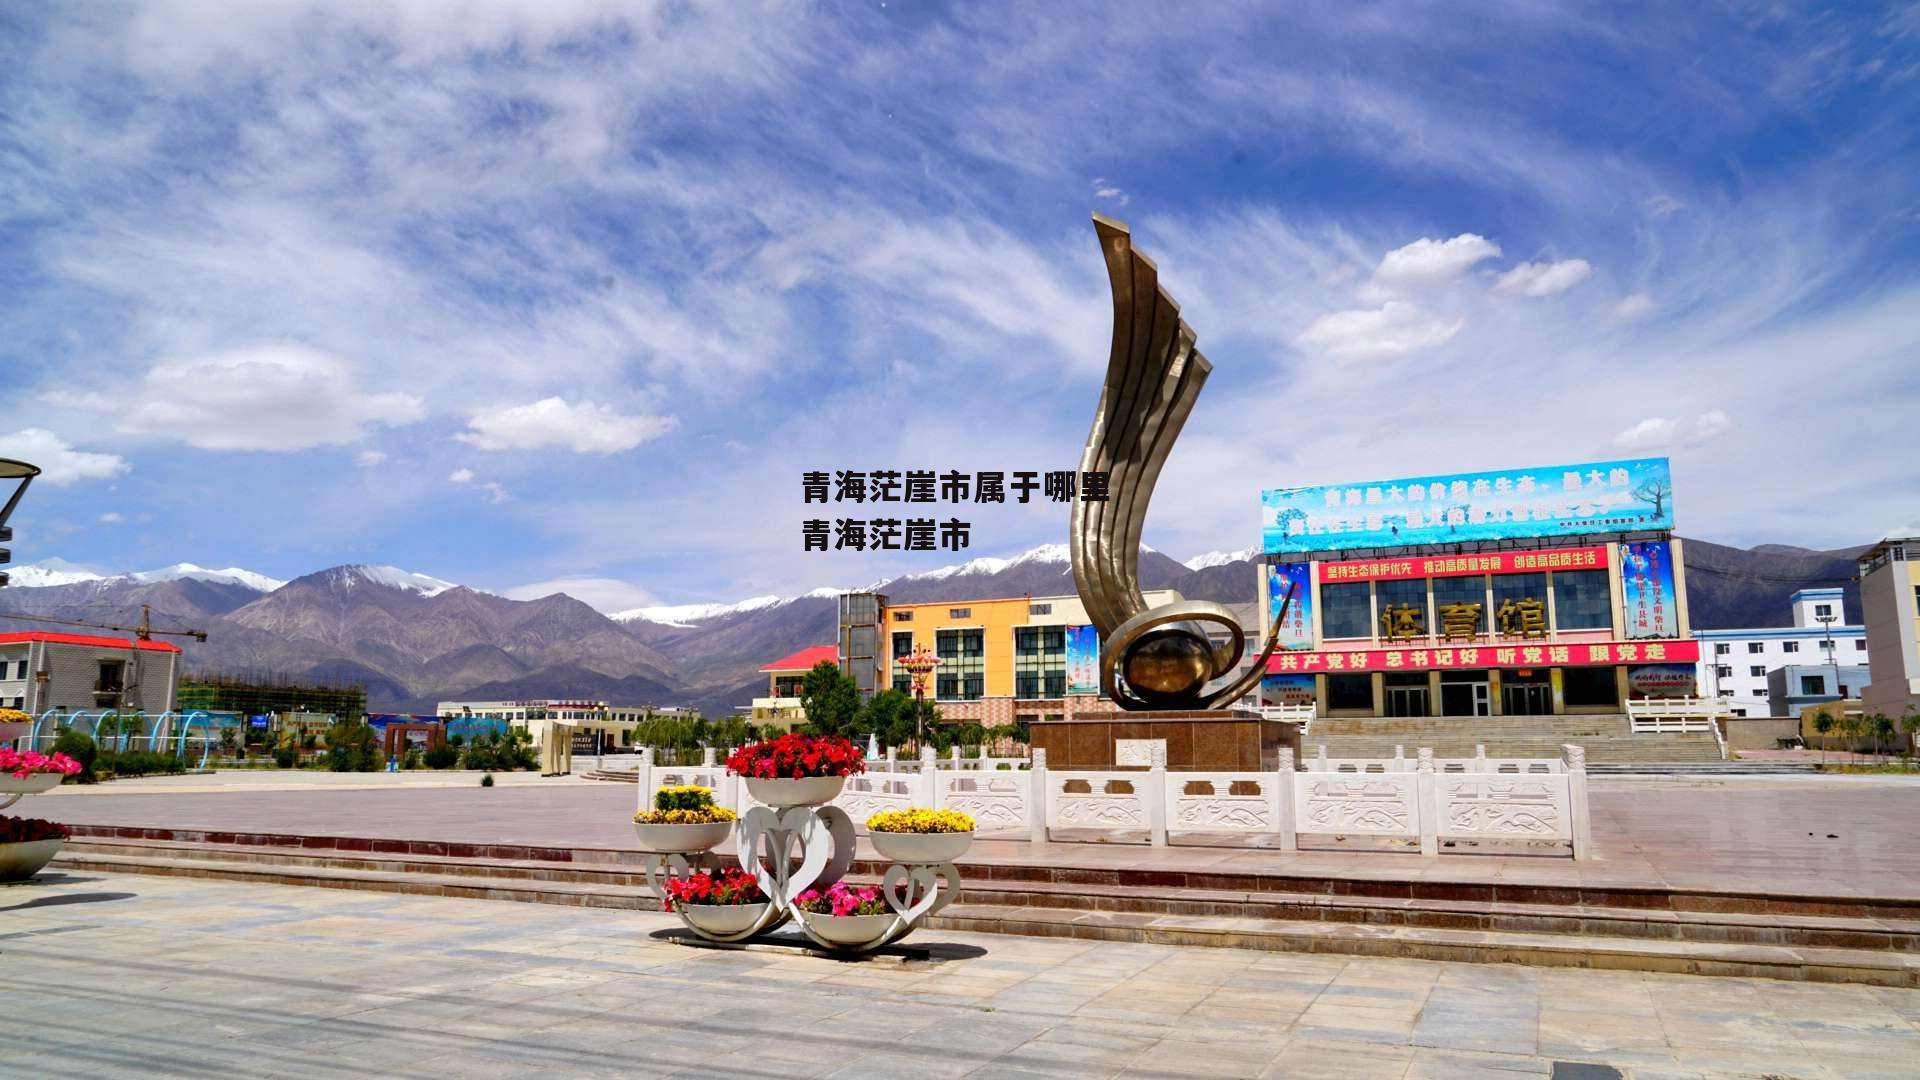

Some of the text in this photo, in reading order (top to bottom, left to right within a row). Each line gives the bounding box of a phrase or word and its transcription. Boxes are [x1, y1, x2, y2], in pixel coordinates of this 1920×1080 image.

[1327, 551, 1596, 578] 坚持生态保护优先 推动高质量发展 创造高品质生活
[1381, 596, 1545, 643] 体育馆
[1280, 643, 1666, 670] 共产党好 总书记好 听党话 跟党走
